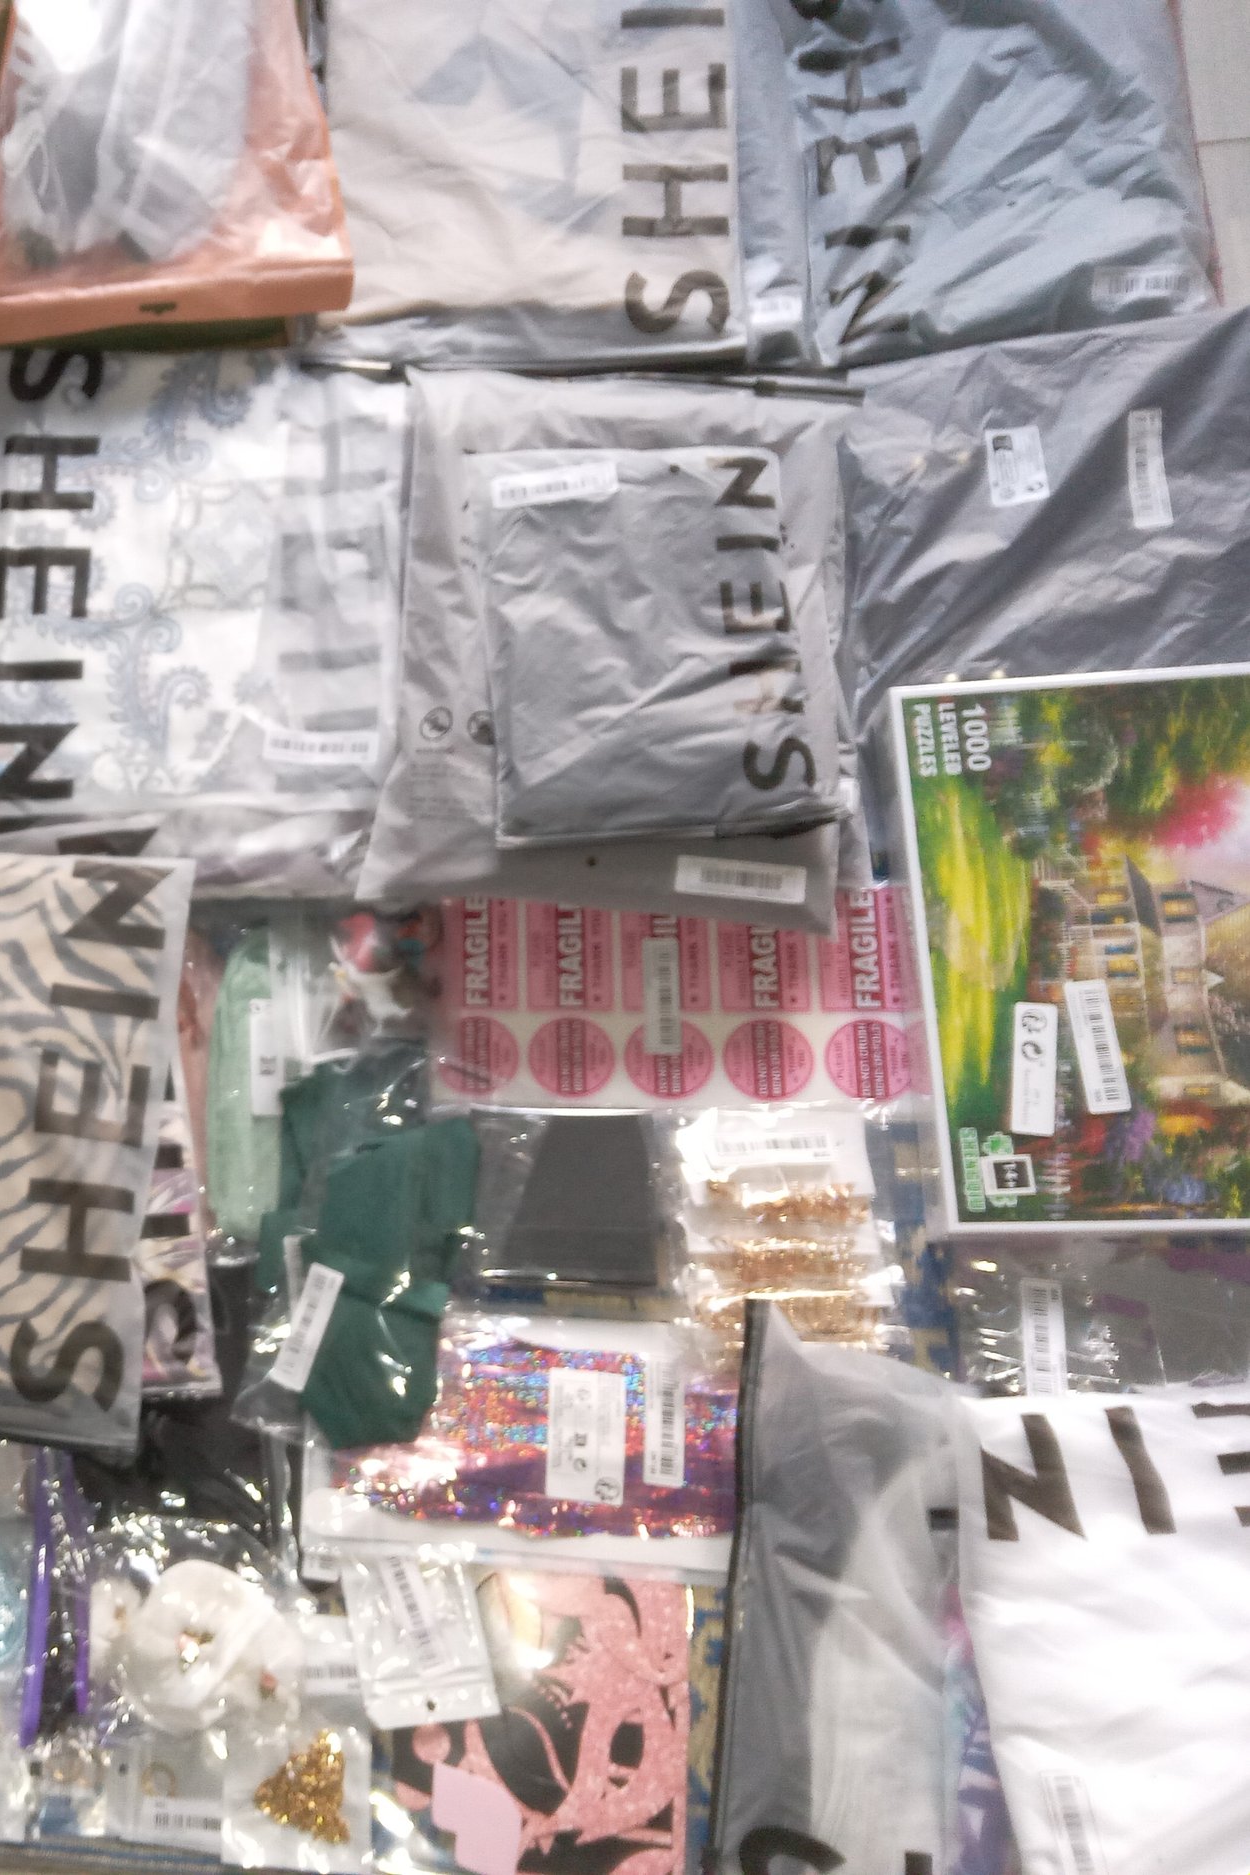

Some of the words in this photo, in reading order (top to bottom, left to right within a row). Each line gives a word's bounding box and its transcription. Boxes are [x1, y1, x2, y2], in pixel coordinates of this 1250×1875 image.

[706, 456, 816, 790] SHEIN
[960, 702, 993, 772] 1000
[849, 889, 882, 1009] FRAGILE
[10, 860, 175, 1409] SHEIN
